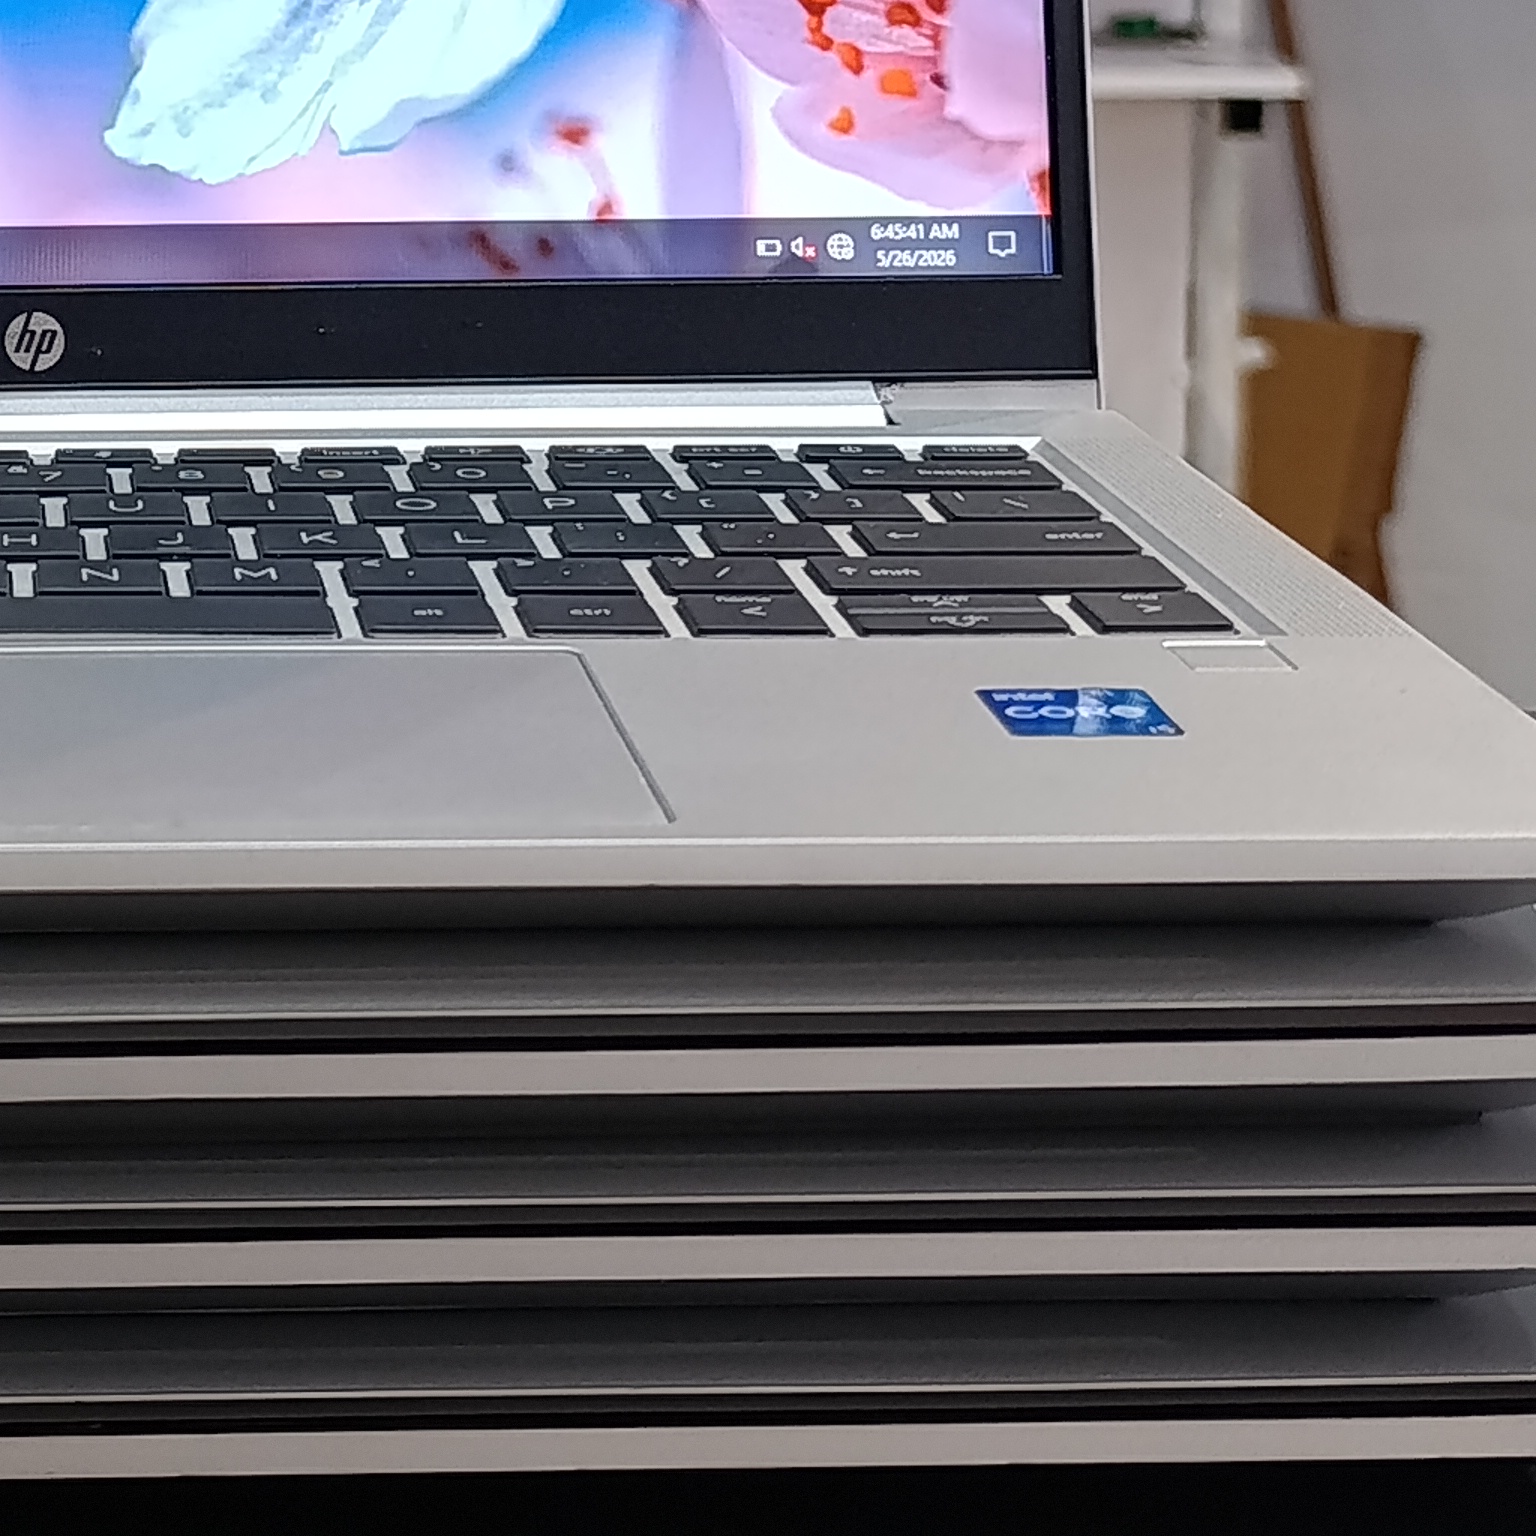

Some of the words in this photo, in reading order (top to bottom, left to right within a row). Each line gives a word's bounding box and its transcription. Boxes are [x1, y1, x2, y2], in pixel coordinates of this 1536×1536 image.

[870, 222, 925, 240] 6:45:41
[929, 222, 960, 239] AM
[876, 249, 957, 267] 5/26/2026
[38, 470, 63, 482] 7
[455, 468, 487, 479] 0
[108, 498, 144, 513] U
[395, 497, 437, 511] O
[543, 497, 576, 510] P
[2, 533, 37, 547] H
[158, 531, 184, 546] J
[299, 530, 338, 545] K
[453, 530, 488, 544] L
[80, 567, 120, 583] N
[233, 566, 279, 582] M
